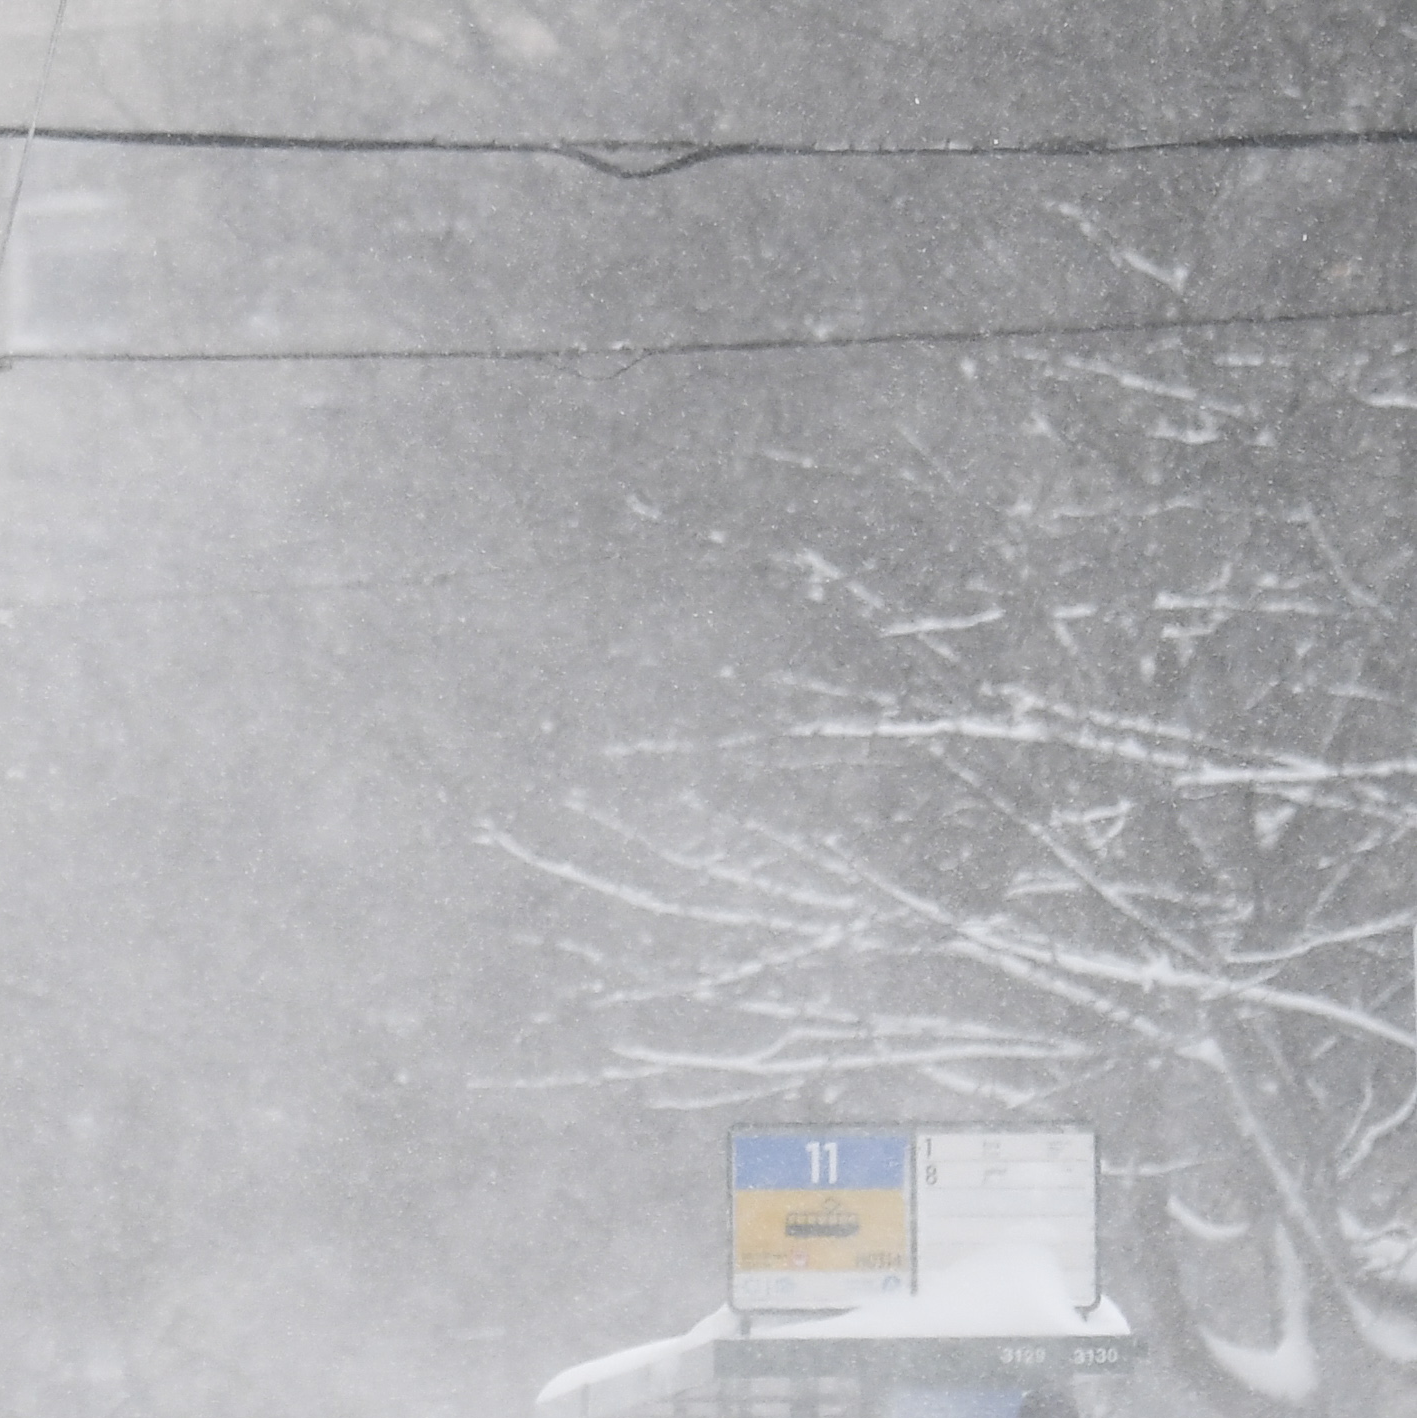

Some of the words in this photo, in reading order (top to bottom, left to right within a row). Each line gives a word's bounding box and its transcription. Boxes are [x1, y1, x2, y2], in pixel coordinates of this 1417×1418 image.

[924, 1138, 933, 1158] 1
[806, 1141, 838, 1184] 11
[925, 1164, 937, 1186] 8
[1000, 1347, 1046, 1364] 3129
[1073, 1347, 1118, 1365] 3130
